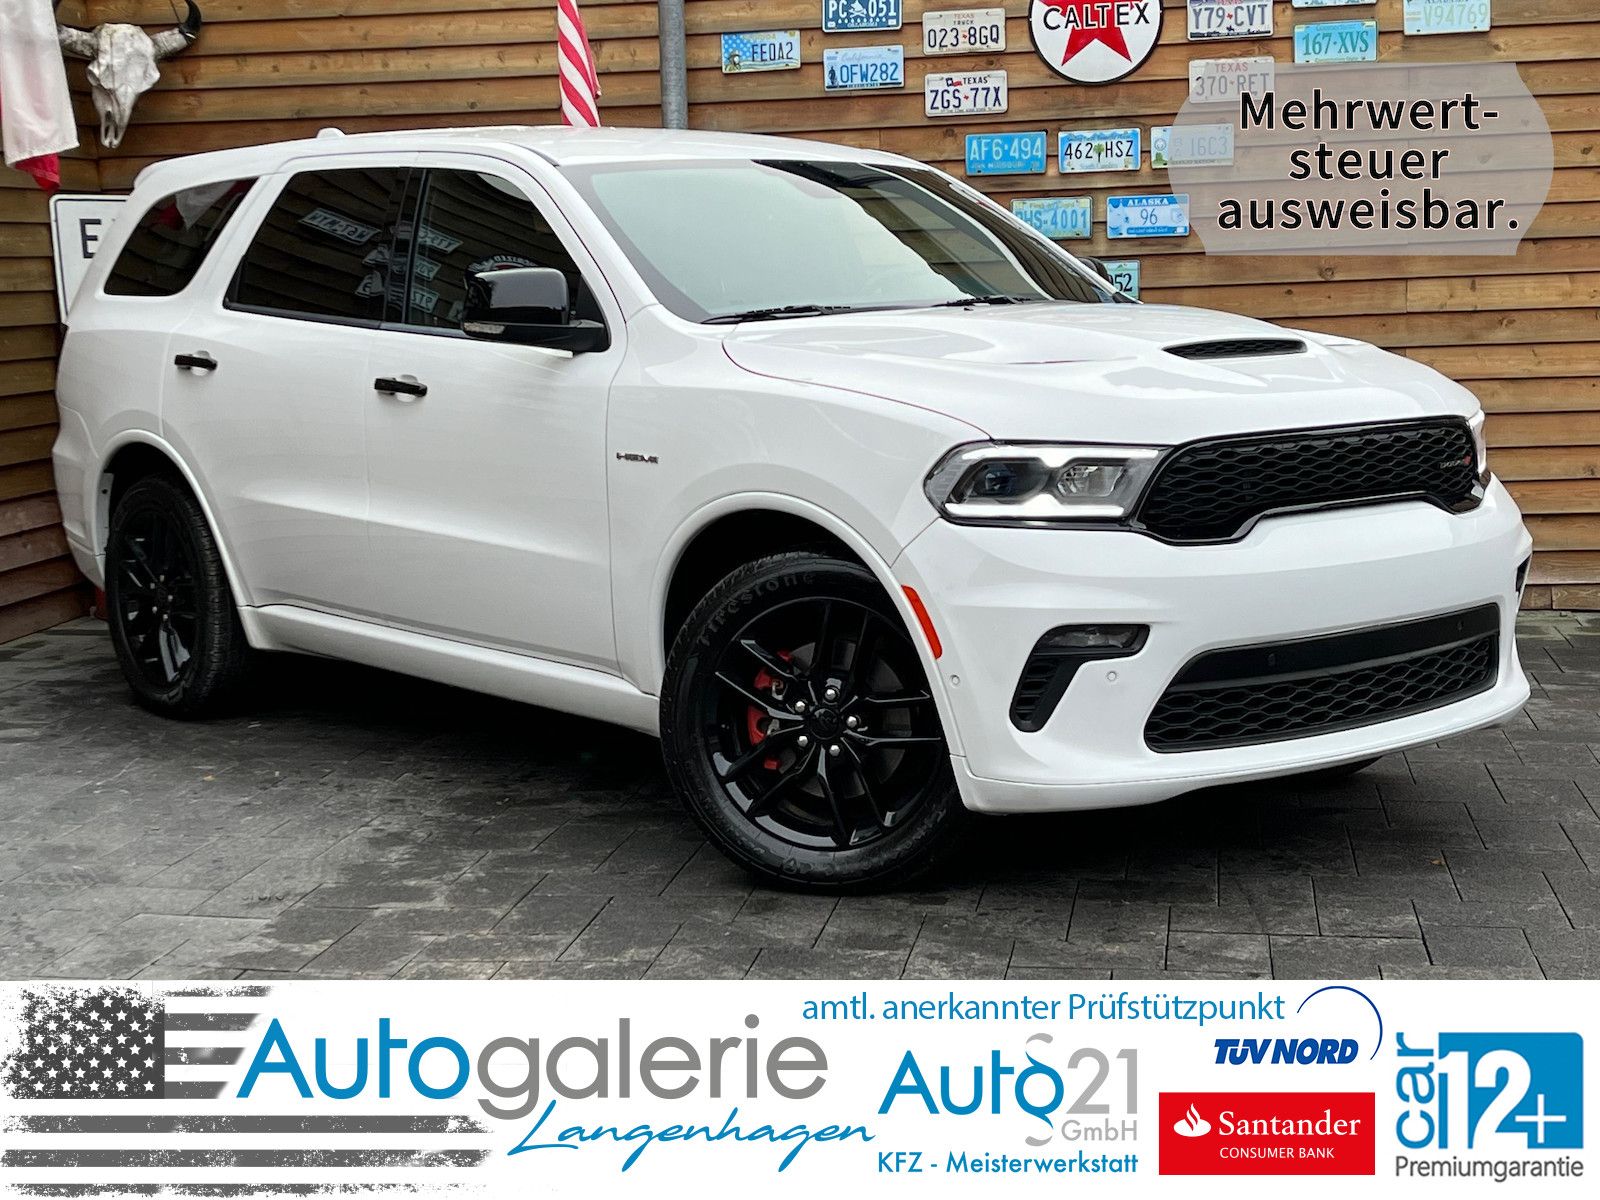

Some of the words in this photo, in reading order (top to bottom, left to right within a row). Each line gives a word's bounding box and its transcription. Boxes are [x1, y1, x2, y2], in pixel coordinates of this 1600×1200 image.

[828, 0, 848, 18] PC
[868, 0, 897, 17] 051
[1043, 3, 1150, 30] CALTEX
[1193, 7, 1226, 29] Y79
[1234, 4, 1267, 26] CVT
[928, 28, 960, 48] 023
[968, 25, 999, 44] 8GQ
[1215, 62, 1249, 73] TEXAS
[963, 77, 988, 85] TEXAS
[1196, 75, 1228, 96] 370
[930, 88, 961, 110] ZGS
[970, 86, 1001, 107] 77X
[1064, 142, 1093, 160] 462
[1105, 140, 1134, 158] HSZ
[1127, 198, 1169, 206] ALASKA
[1141, 208, 1158, 225] 96
